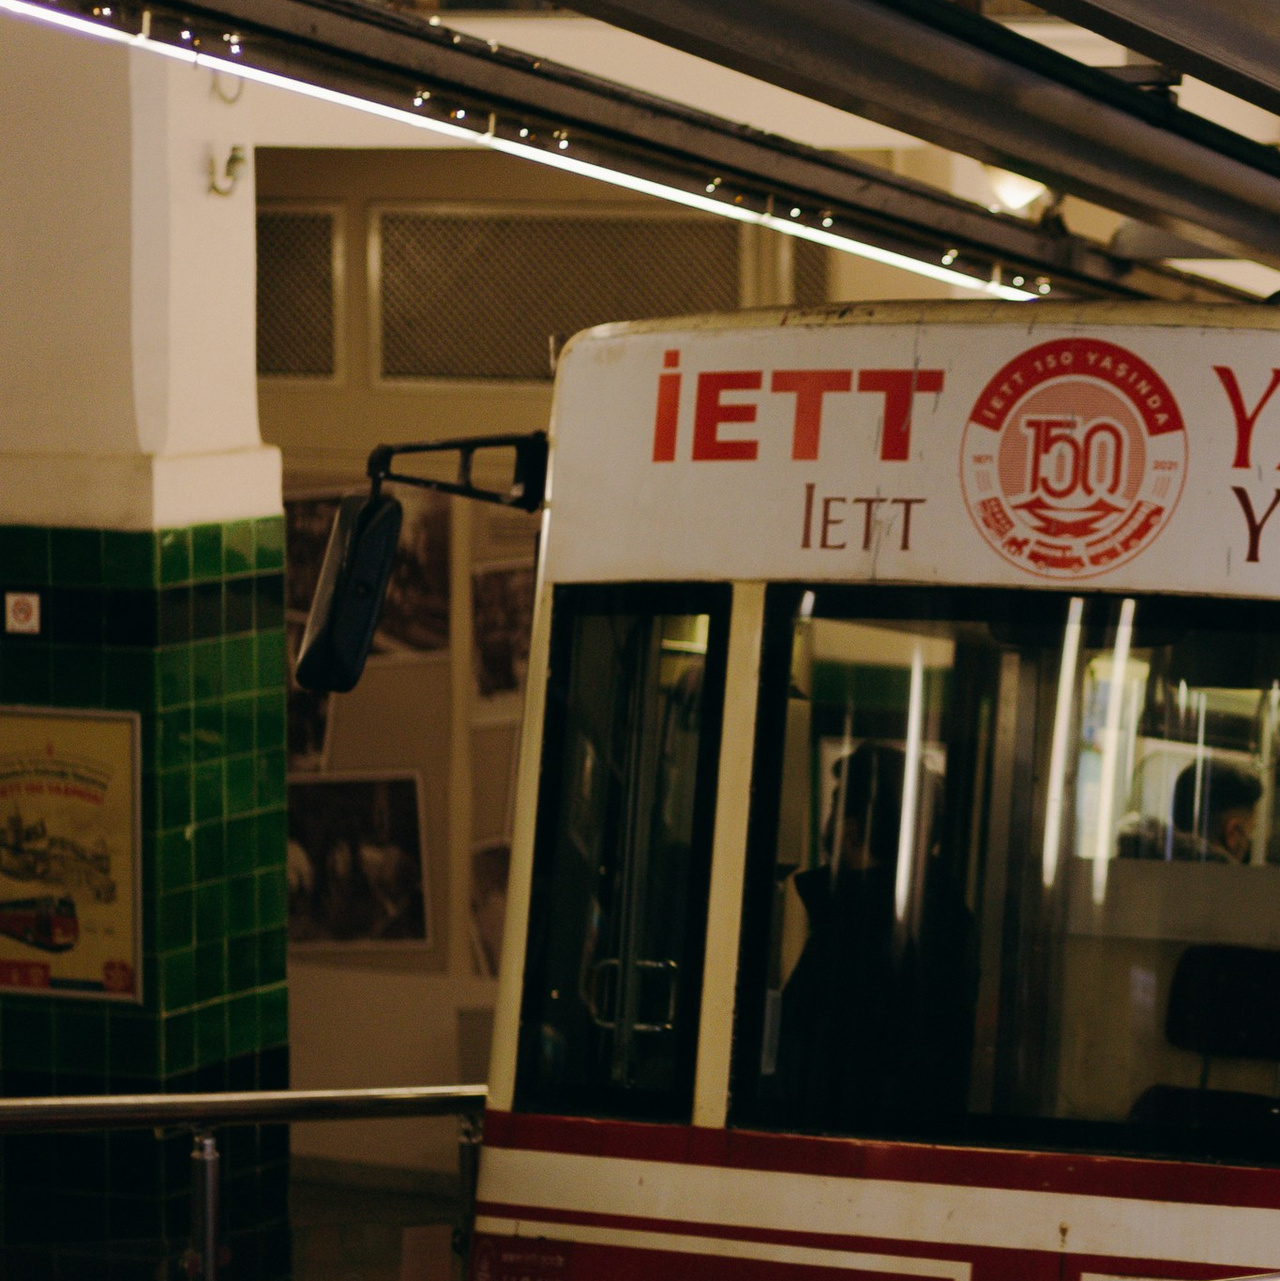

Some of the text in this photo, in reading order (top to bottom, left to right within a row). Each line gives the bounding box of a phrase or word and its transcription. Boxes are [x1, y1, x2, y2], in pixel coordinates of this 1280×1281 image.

[1033, 351, 1075, 374] 150
[1026, 419, 1124, 498] 150
[801, 483, 927, 551] IETT
